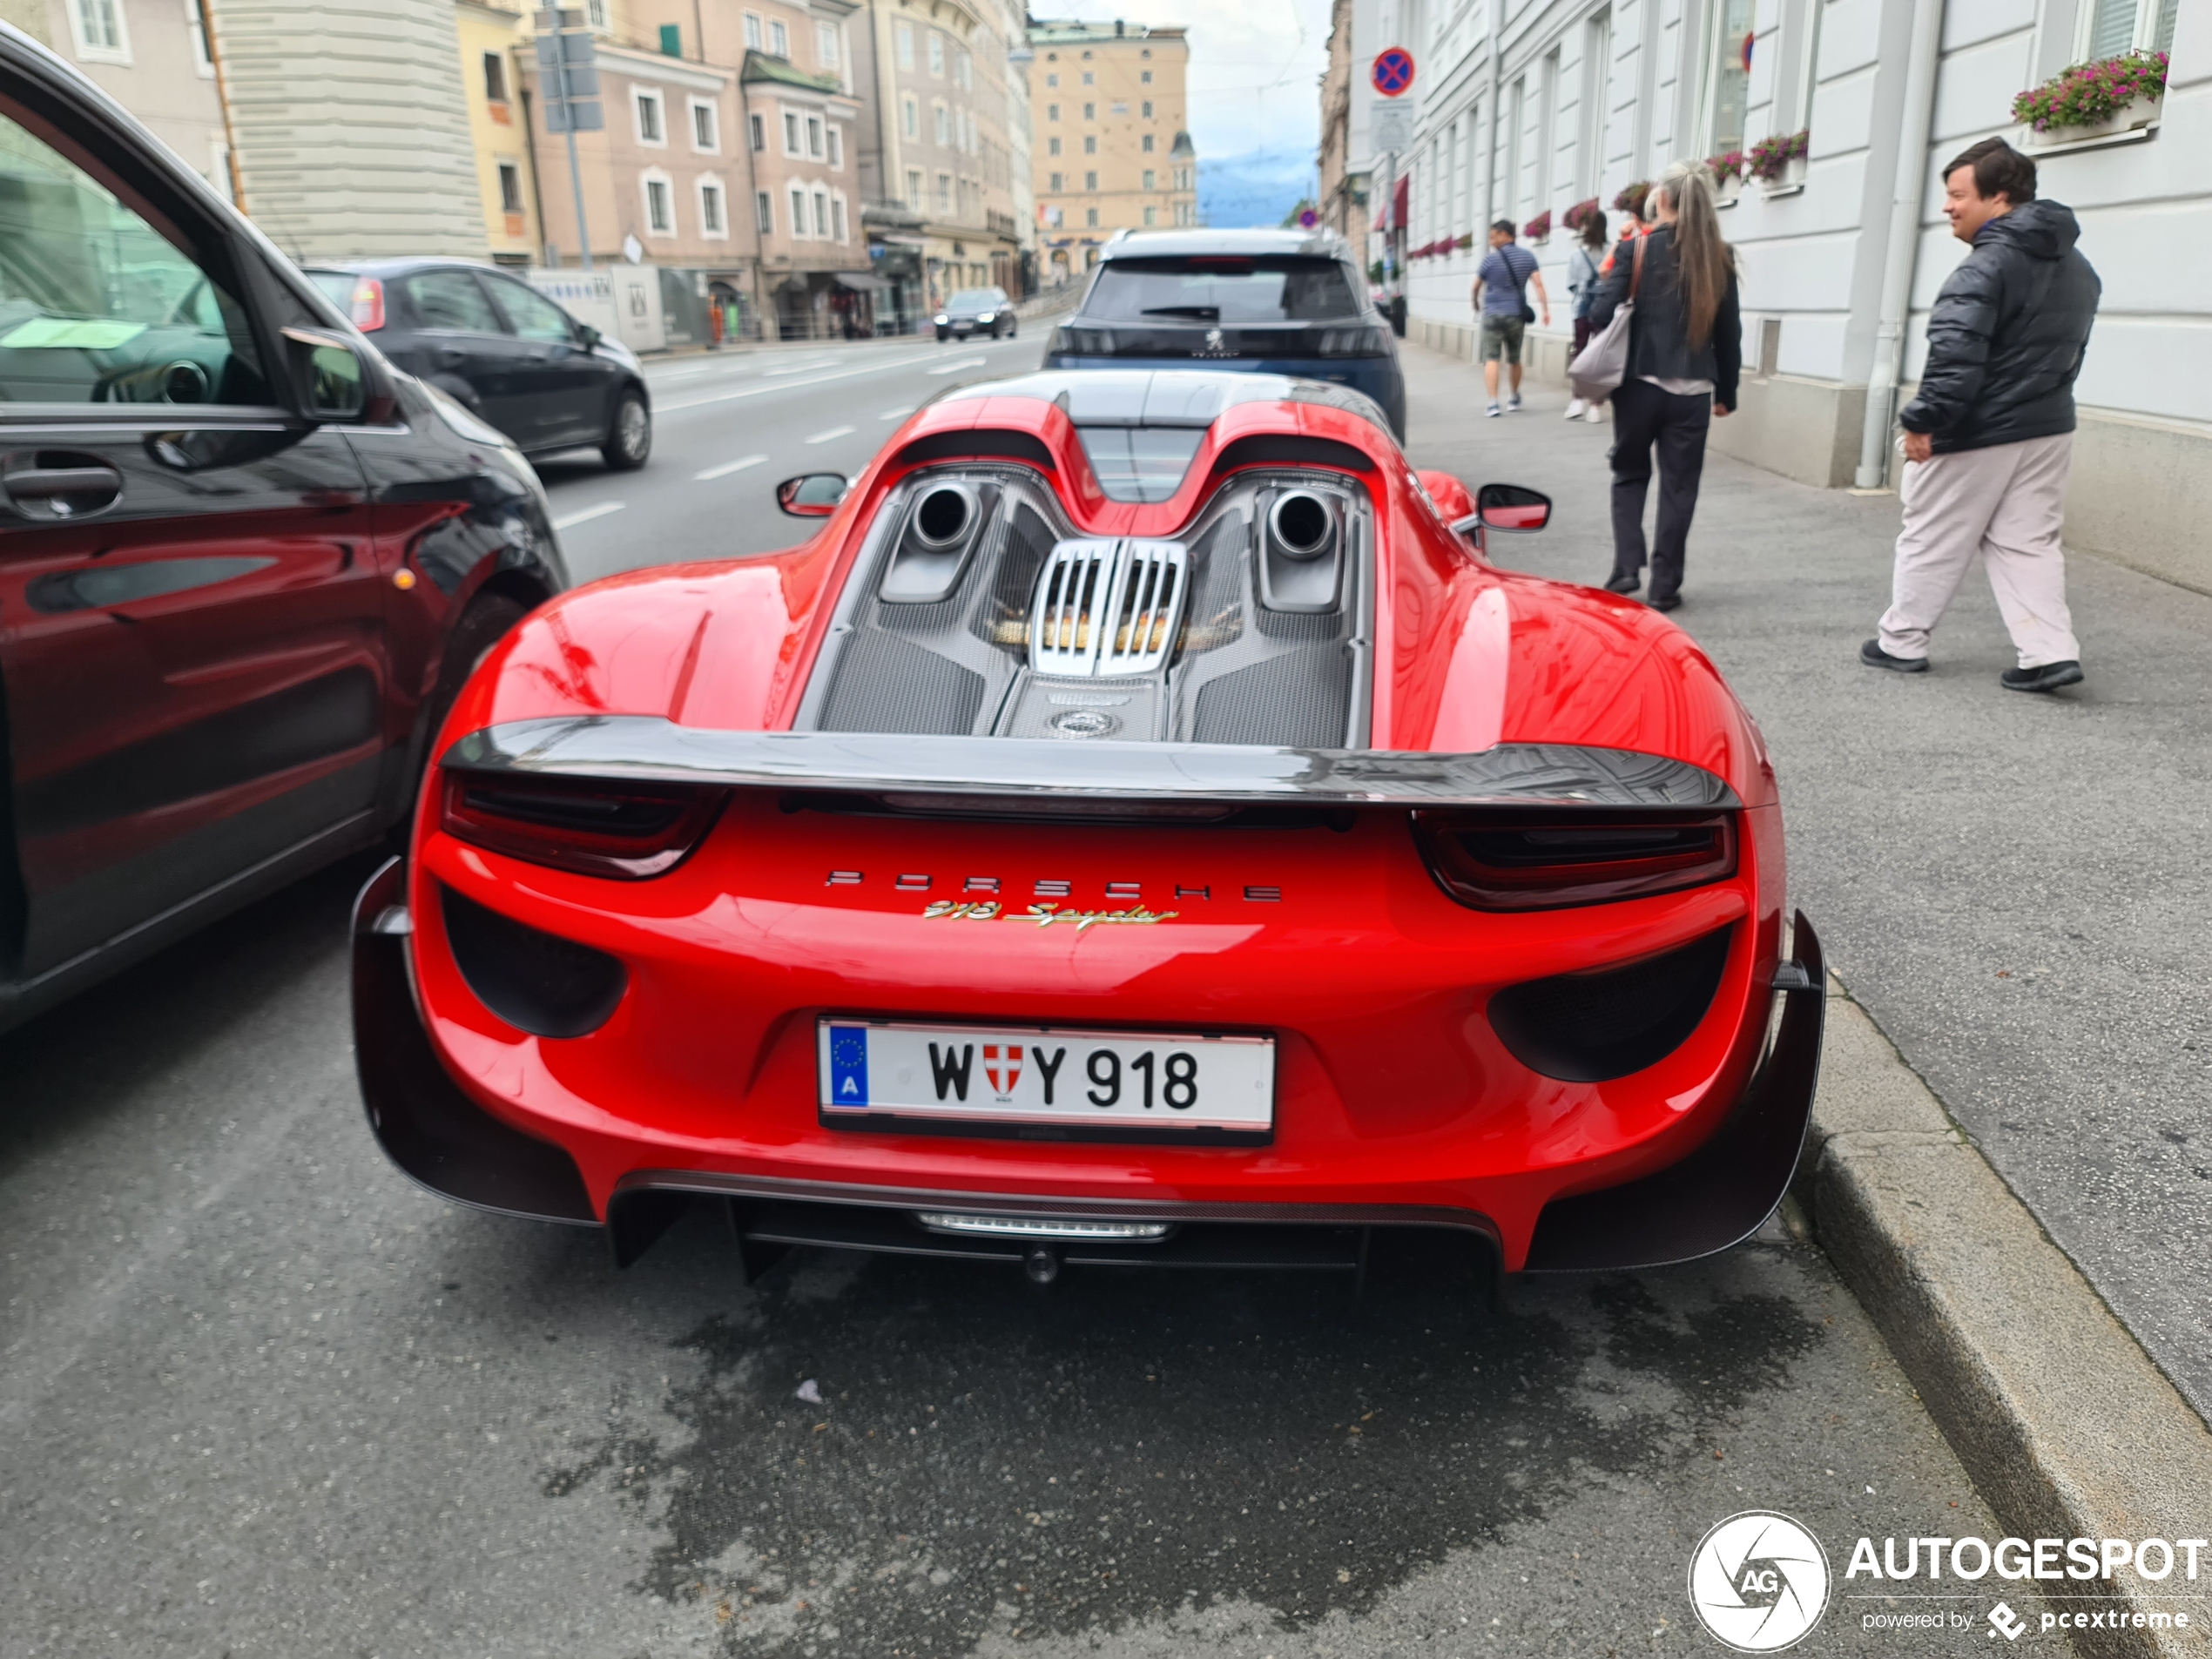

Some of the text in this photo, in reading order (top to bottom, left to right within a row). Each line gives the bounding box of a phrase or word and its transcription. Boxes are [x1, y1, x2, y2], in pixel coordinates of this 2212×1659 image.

[824, 869, 1283, 903] PORSCHE
[922, 900, 1179, 931] 918 Spyder
[841, 1076, 860, 1096] A
[927, 1042, 1198, 1110] W Y 918
